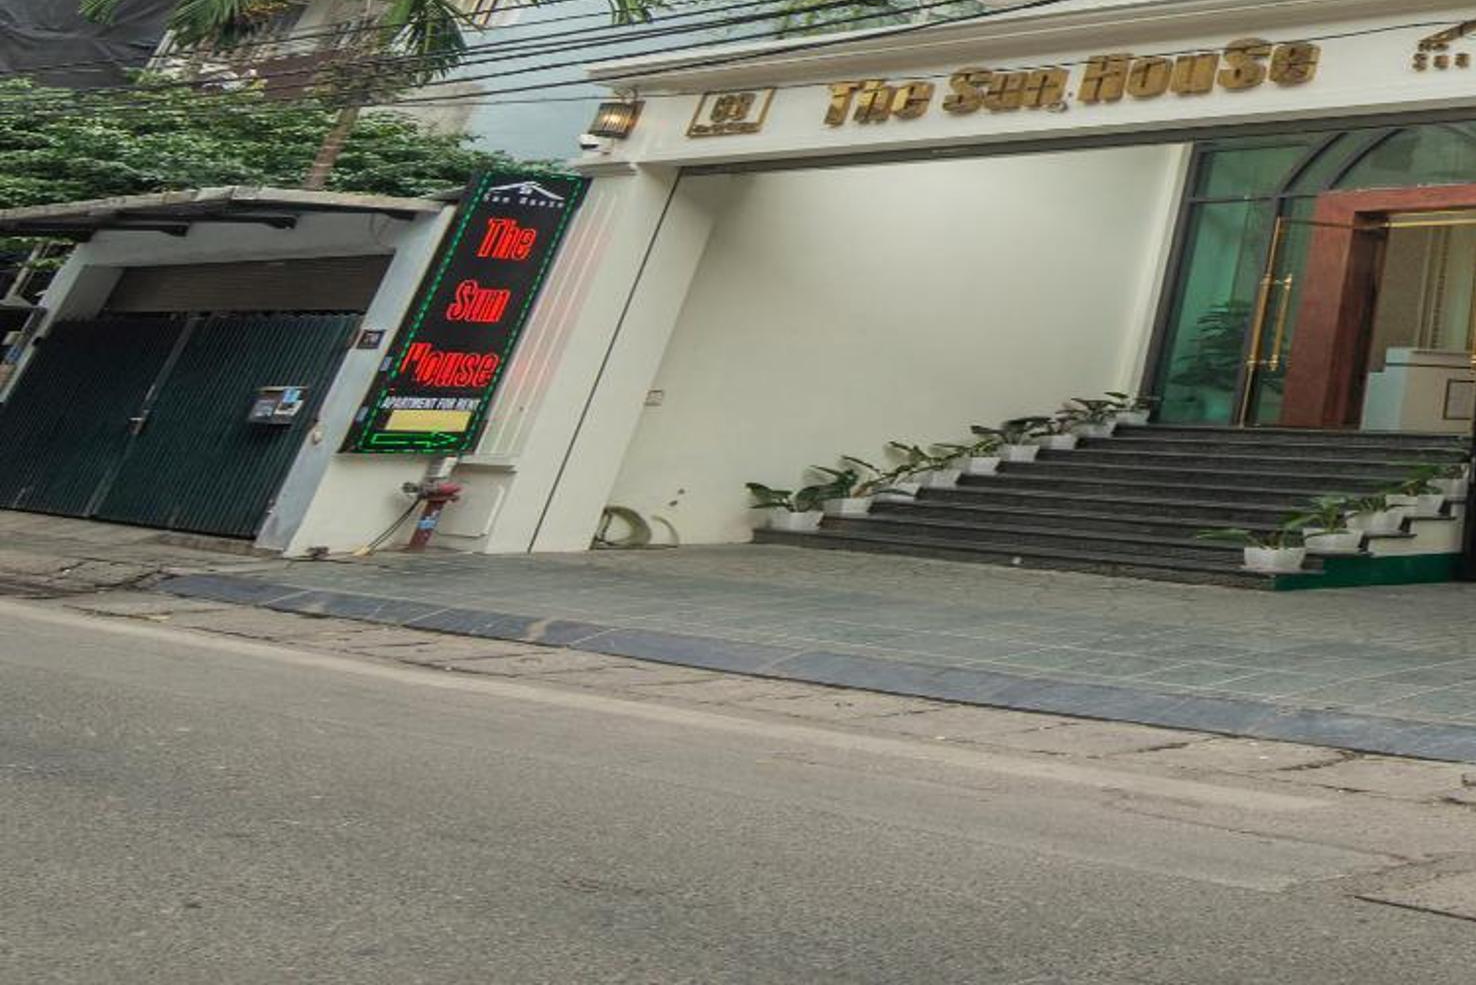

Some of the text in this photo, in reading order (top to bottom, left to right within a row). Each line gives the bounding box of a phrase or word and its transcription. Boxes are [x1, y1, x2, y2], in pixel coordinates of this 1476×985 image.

[824, 79, 936, 127] The
[943, 67, 1069, 116] Sun
[477, 218, 537, 260] The
[446, 279, 511, 323] Sun
[400, 342, 499, 387] House
[380, 396, 440, 409] APARTMENT
